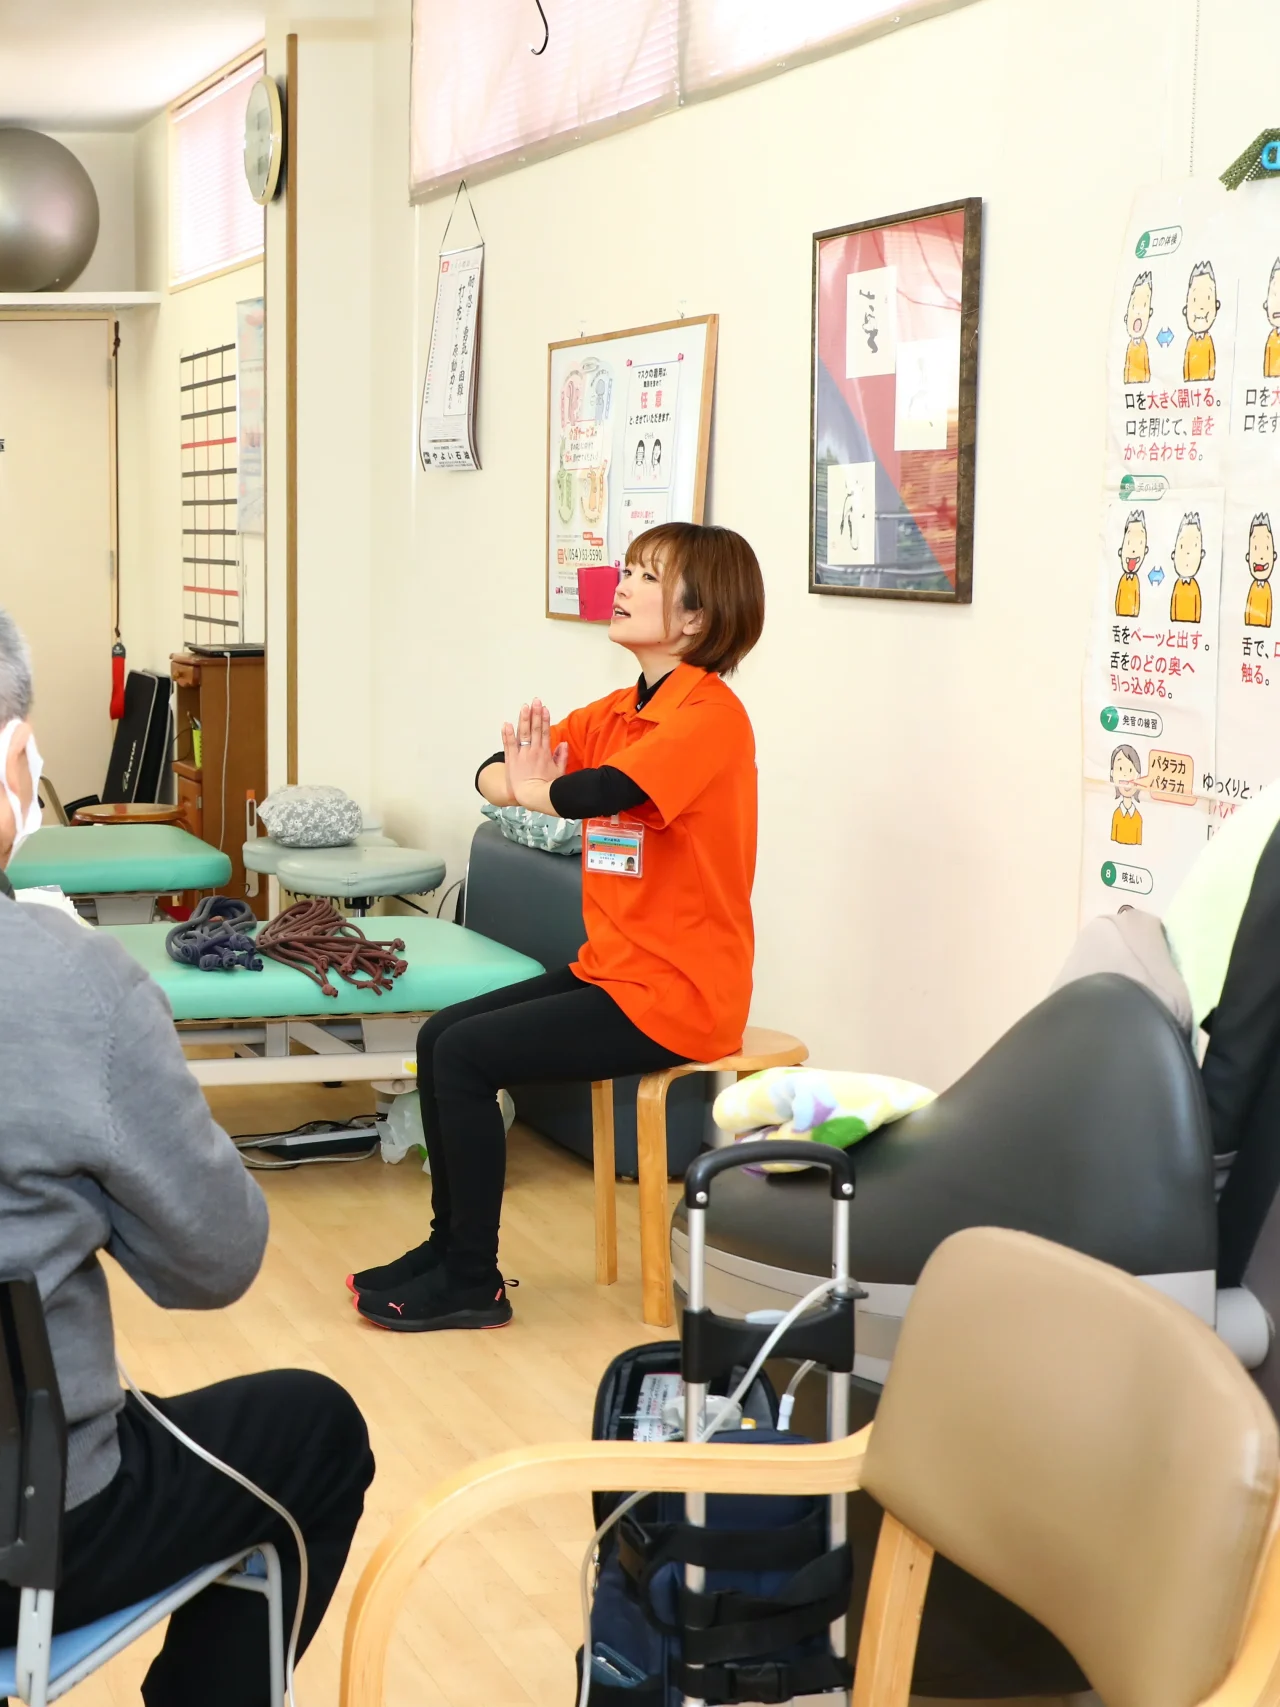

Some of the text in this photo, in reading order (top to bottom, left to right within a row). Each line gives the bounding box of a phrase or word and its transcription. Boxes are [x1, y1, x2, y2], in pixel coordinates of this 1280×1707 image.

[1152, 232, 1178, 247] 口の体操
[1125, 387, 1221, 410] 口を大きく開ける。
[1125, 415, 1215, 438] 口を閉じて、歯を
[1123, 441, 1203, 462] かみ合わせる。
[1110, 651, 1195, 676] 舌をのどの奥へ
[1240, 662, 1270, 686] 触る。
[1110, 674, 1173, 699] 引っ込める。
[1122, 714, 1158, 730] 発音の練習
[1151, 755, 1186, 775] パタラカ
[1149, 776, 1185, 794] パタラカ
[1121, 871, 1143, 886] 咳払い
